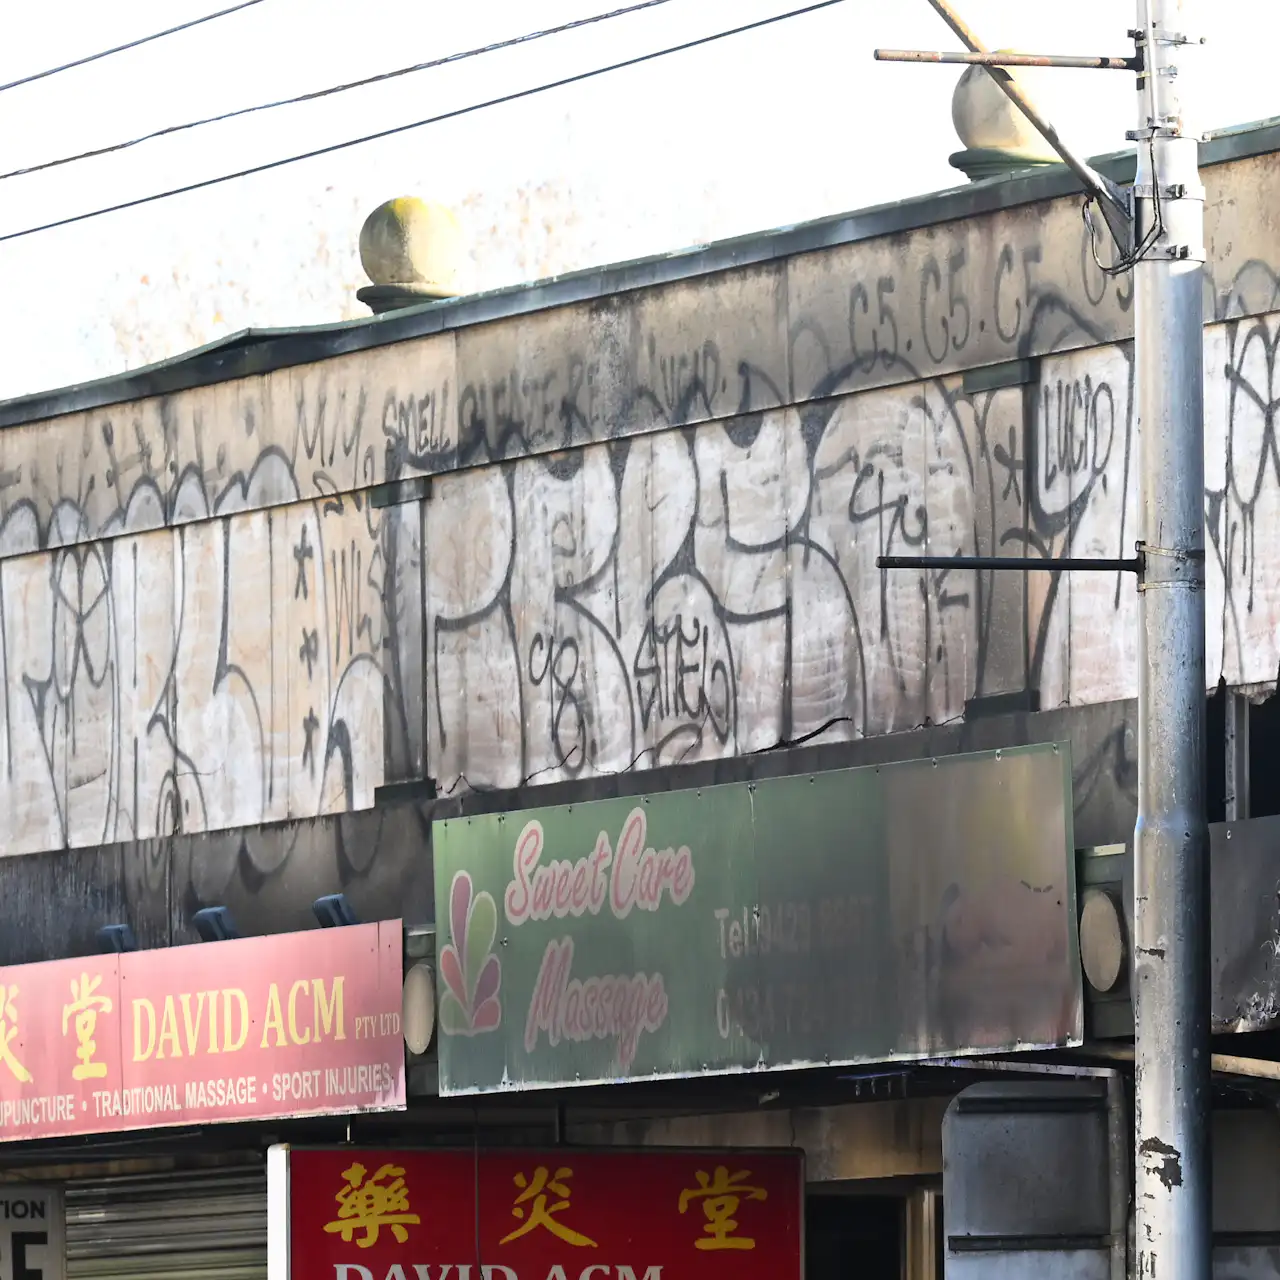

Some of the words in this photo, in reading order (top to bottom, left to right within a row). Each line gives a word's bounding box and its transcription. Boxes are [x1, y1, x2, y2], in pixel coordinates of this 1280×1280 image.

[505, 819, 612, 925] Sweet
[610, 806, 695, 919] Care
[132, 988, 249, 1062] DAVID
[260, 976, 347, 1048] ACM
[355, 1016, 377, 1040] PTY
[379, 1011, 400, 1036] LTD
[525, 935, 668, 1068] Massage
[93, 1081, 182, 1118] TRADITIONAL
[185, 1076, 257, 1107] MASSAGE
[272, 1070, 321, 1101] SPORT
[324, 1062, 396, 1095] INJURIES
[0, 1201, 46, 1219] ION
